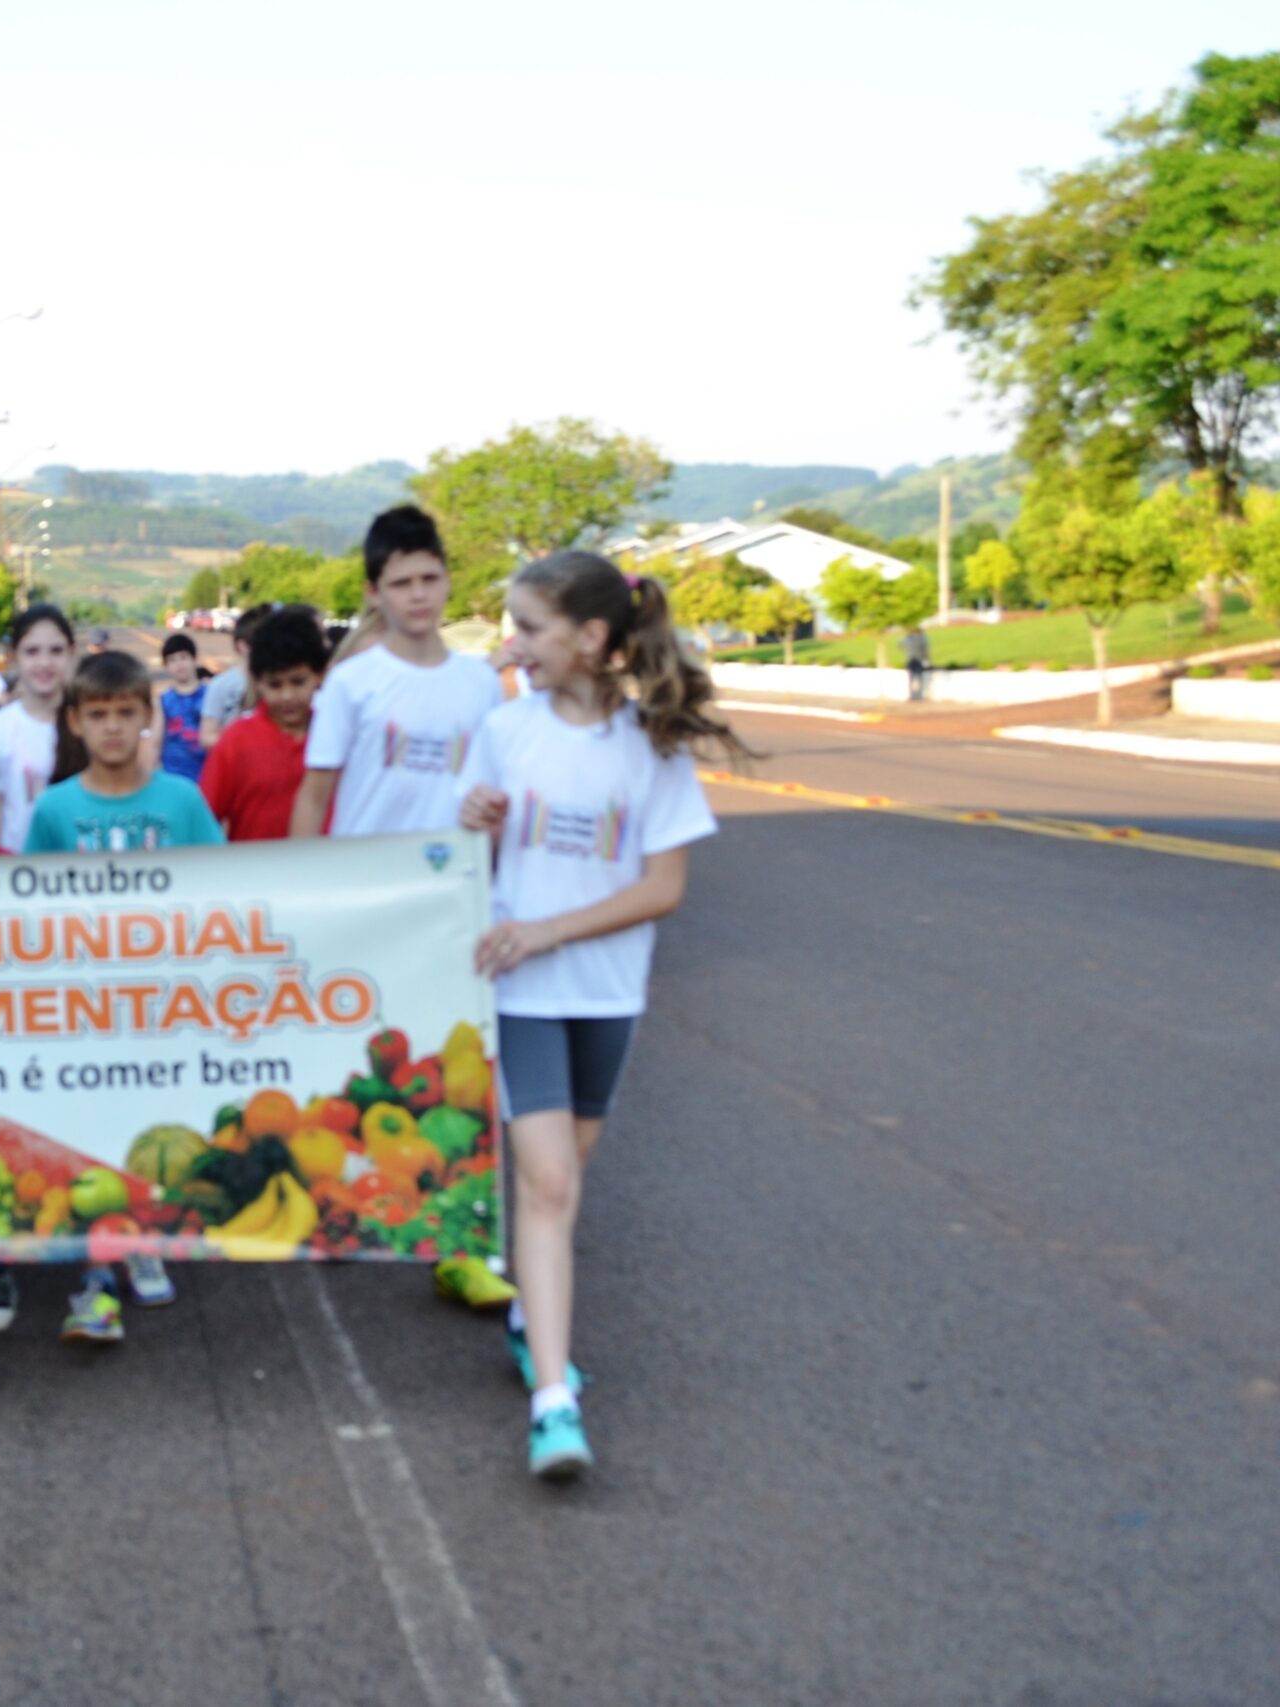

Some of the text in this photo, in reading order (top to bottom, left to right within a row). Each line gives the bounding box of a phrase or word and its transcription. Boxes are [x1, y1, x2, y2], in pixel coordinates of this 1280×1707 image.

[9, 859, 172, 898] Outubro
[21, 1055, 43, 1091] é
[57, 1062, 186, 1090] comer
[200, 1050, 291, 1085] bem
